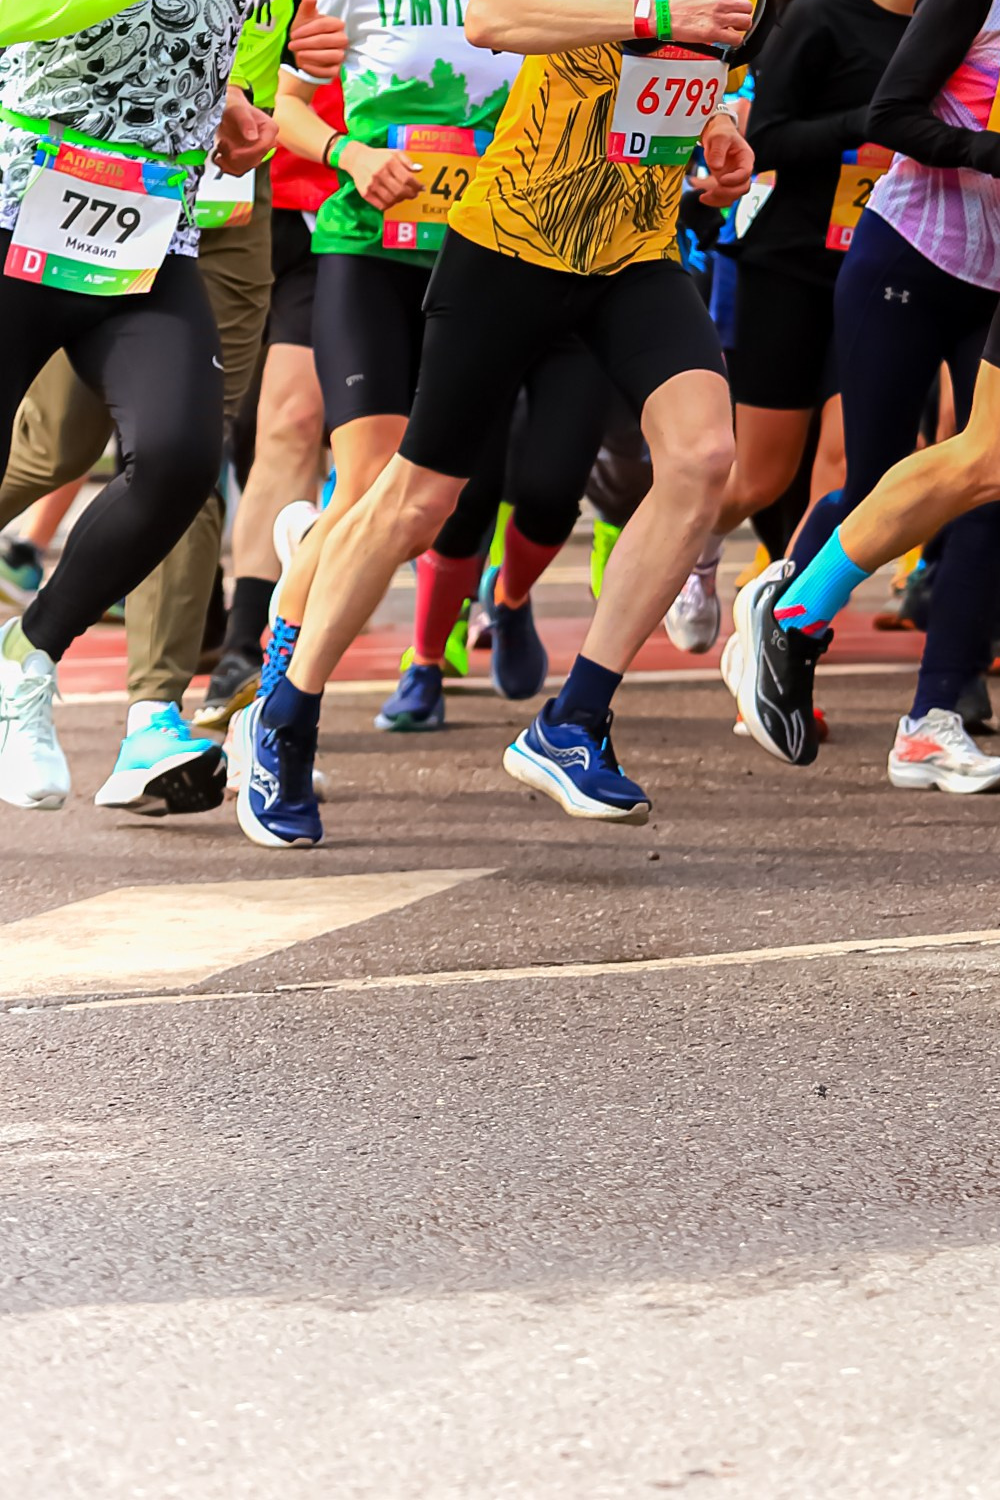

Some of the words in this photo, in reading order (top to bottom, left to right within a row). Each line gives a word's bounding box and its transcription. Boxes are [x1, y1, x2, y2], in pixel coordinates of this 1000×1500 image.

[636, 77, 719, 116] 6793
[629, 132, 646, 154] D
[63, 151, 125, 178] АПРЕЛЬ
[59, 189, 141, 244] 779
[397, 222, 414, 242] B
[65, 237, 117, 259] Михаил
[22, 251, 42, 274] D
